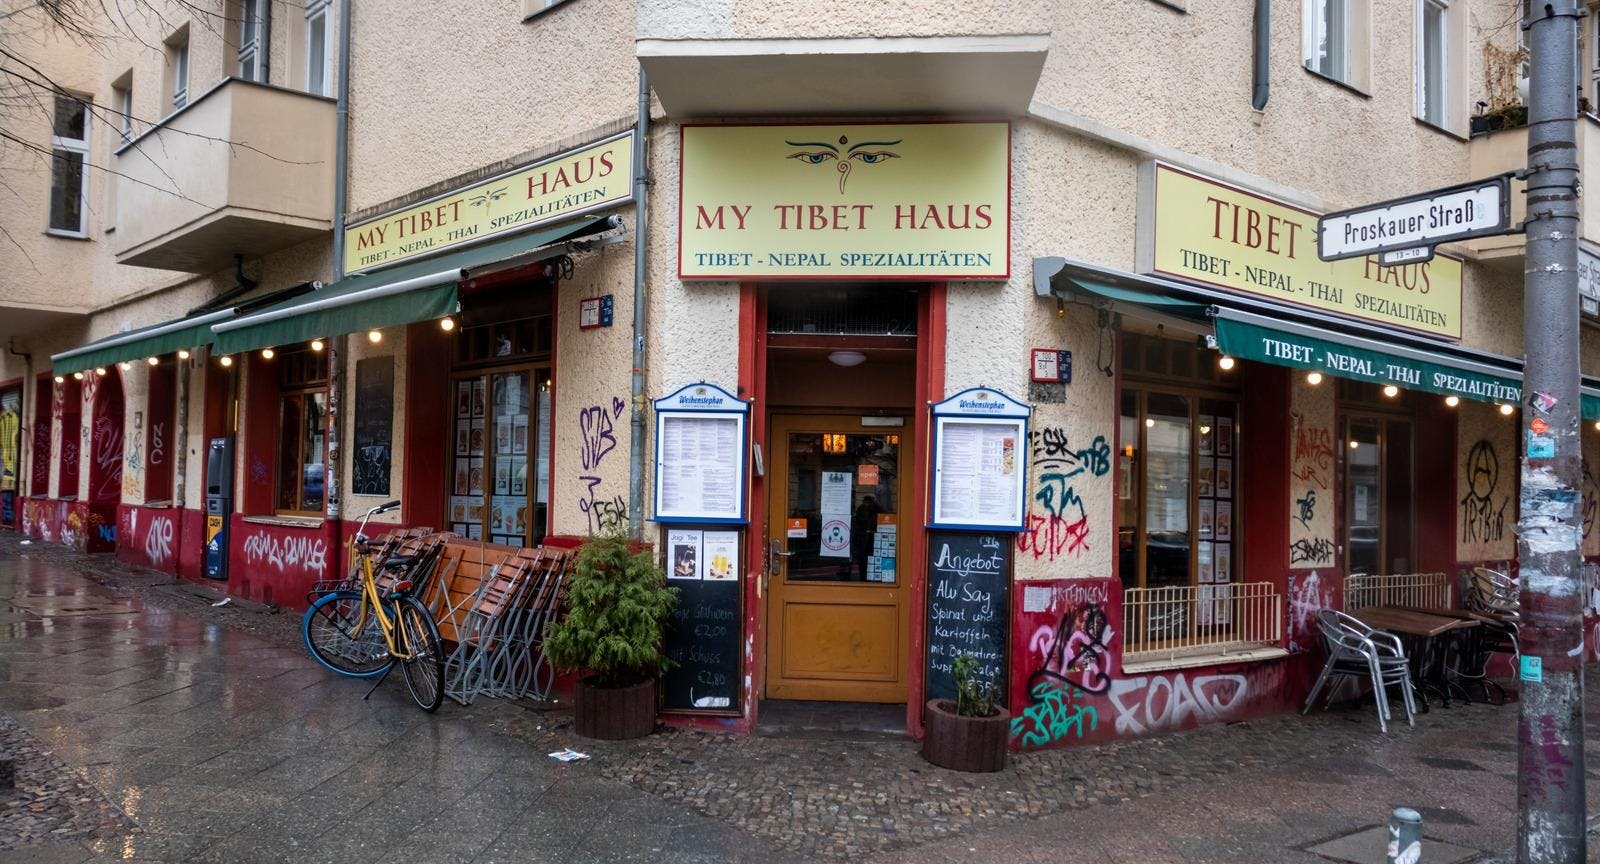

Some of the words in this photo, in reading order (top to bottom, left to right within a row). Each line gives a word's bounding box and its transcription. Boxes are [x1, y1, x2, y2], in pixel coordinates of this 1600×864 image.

[357, 224, 389, 251] MY
[394, 199, 465, 238] TIBET
[527, 150, 614, 200] HAUS
[360, 251, 389, 266] TIBET
[399, 238, 437, 255] NEPAL
[446, 225, 478, 242] THAI
[490, 186, 607, 230] SPEZIALITÄTEN
[695, 204, 752, 230] MY
[774, 204, 873, 232] TIBET
[894, 203, 992, 230] HAUS
[1207, 197, 1302, 260] TIBET
[1345, 214, 1425, 245] Proskauer
[695, 253, 752, 266] TIBET
[768, 253, 831, 267] NEPAL
[840, 250, 991, 267] SPEZIALITÄTEN
[1180, 248, 1231, 277] TIBET
[1244, 265, 1295, 293] NEPAL
[1308, 281, 1344, 304] THAI
[1355, 293, 1447, 328] SPEZIALITÄTEN
[1263, 337, 1313, 364] TIBET
[1326, 351, 1376, 377] NEPAL
[1387, 364, 1421, 385] THAI
[1434, 372, 1522, 402] SPEZIALITÄTEN
[679, 394, 723, 406] Weihenstephan
[960, 399, 1005, 410] Weihenstephan
[934, 543, 1003, 576] Angebot
[931, 603, 966, 621] Spinat
[972, 611, 993, 622] und
[935, 625, 991, 644] Kartoffeln
[931, 645, 945, 656] mit
